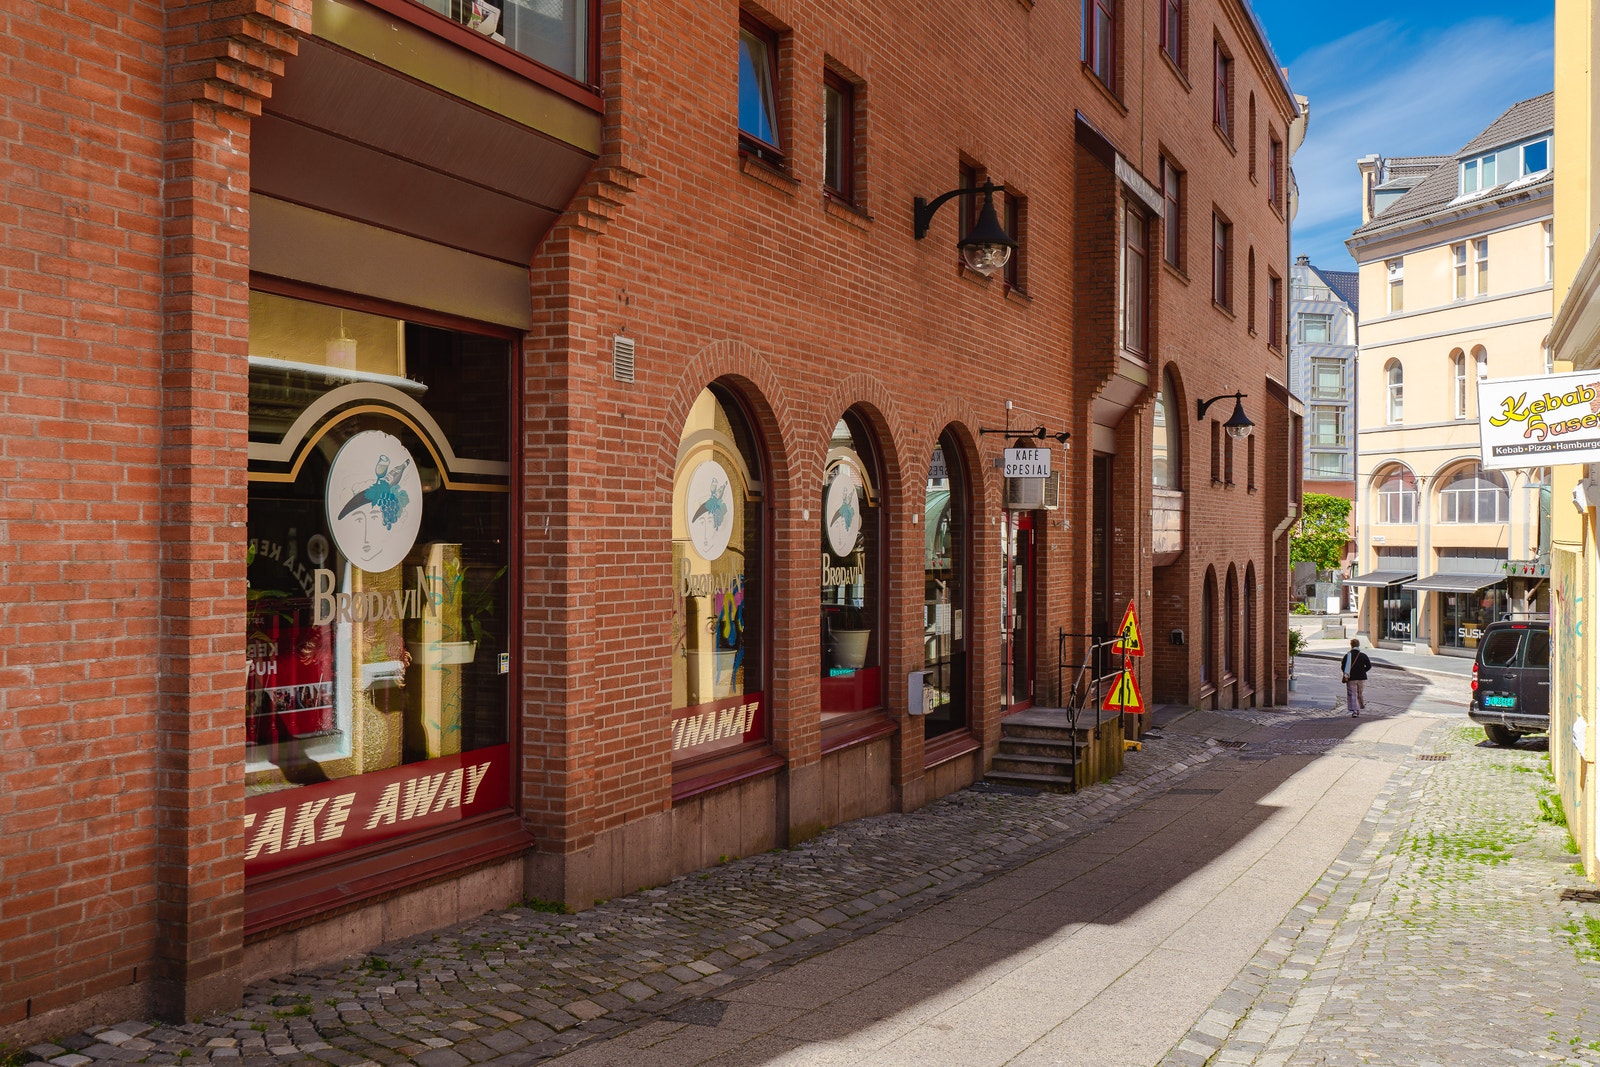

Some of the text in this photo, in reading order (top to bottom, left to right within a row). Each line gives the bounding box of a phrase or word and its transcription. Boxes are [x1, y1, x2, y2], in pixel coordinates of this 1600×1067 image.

[1489, 384, 1596, 427] Kebab
[1523, 412, 1600, 441] Huse
[1496, 446, 1524, 455] Kebab
[1528, 444, 1552, 453] Pizza
[1006, 464, 1048, 475] SPESIAL
[1391, 621, 1410, 633] WOK
[362, 761, 492, 831] AWAY
